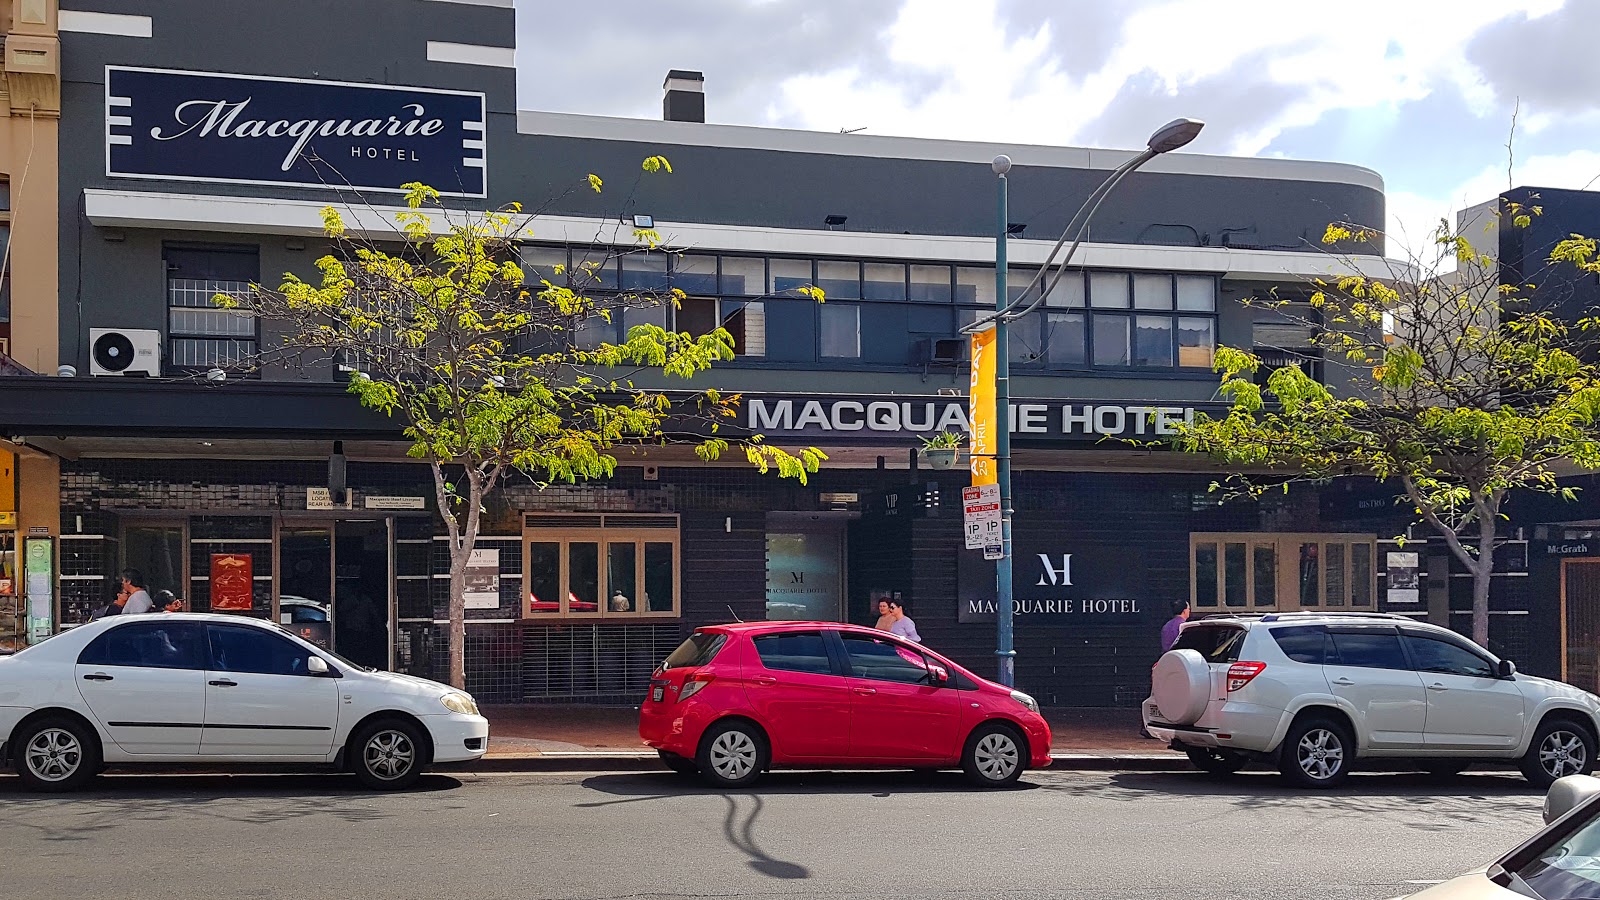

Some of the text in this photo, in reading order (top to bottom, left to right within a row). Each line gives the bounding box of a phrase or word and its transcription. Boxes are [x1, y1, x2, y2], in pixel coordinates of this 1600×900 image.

[150, 96, 445, 172] Macquarie
[351, 146, 420, 162] HOTEL
[748, 399, 1048, 433] MACQUAIE
[969, 393, 979, 477] ANZAC
[977, 419, 988, 476] 25 APRIL
[885, 493, 898, 508] VIP
[968, 524, 980, 535] 1P
[986, 521, 998, 532] 1P
[1547, 544, 1588, 554] McGrath
[968, 600, 1140, 615] MAQUARIE HOTEL
